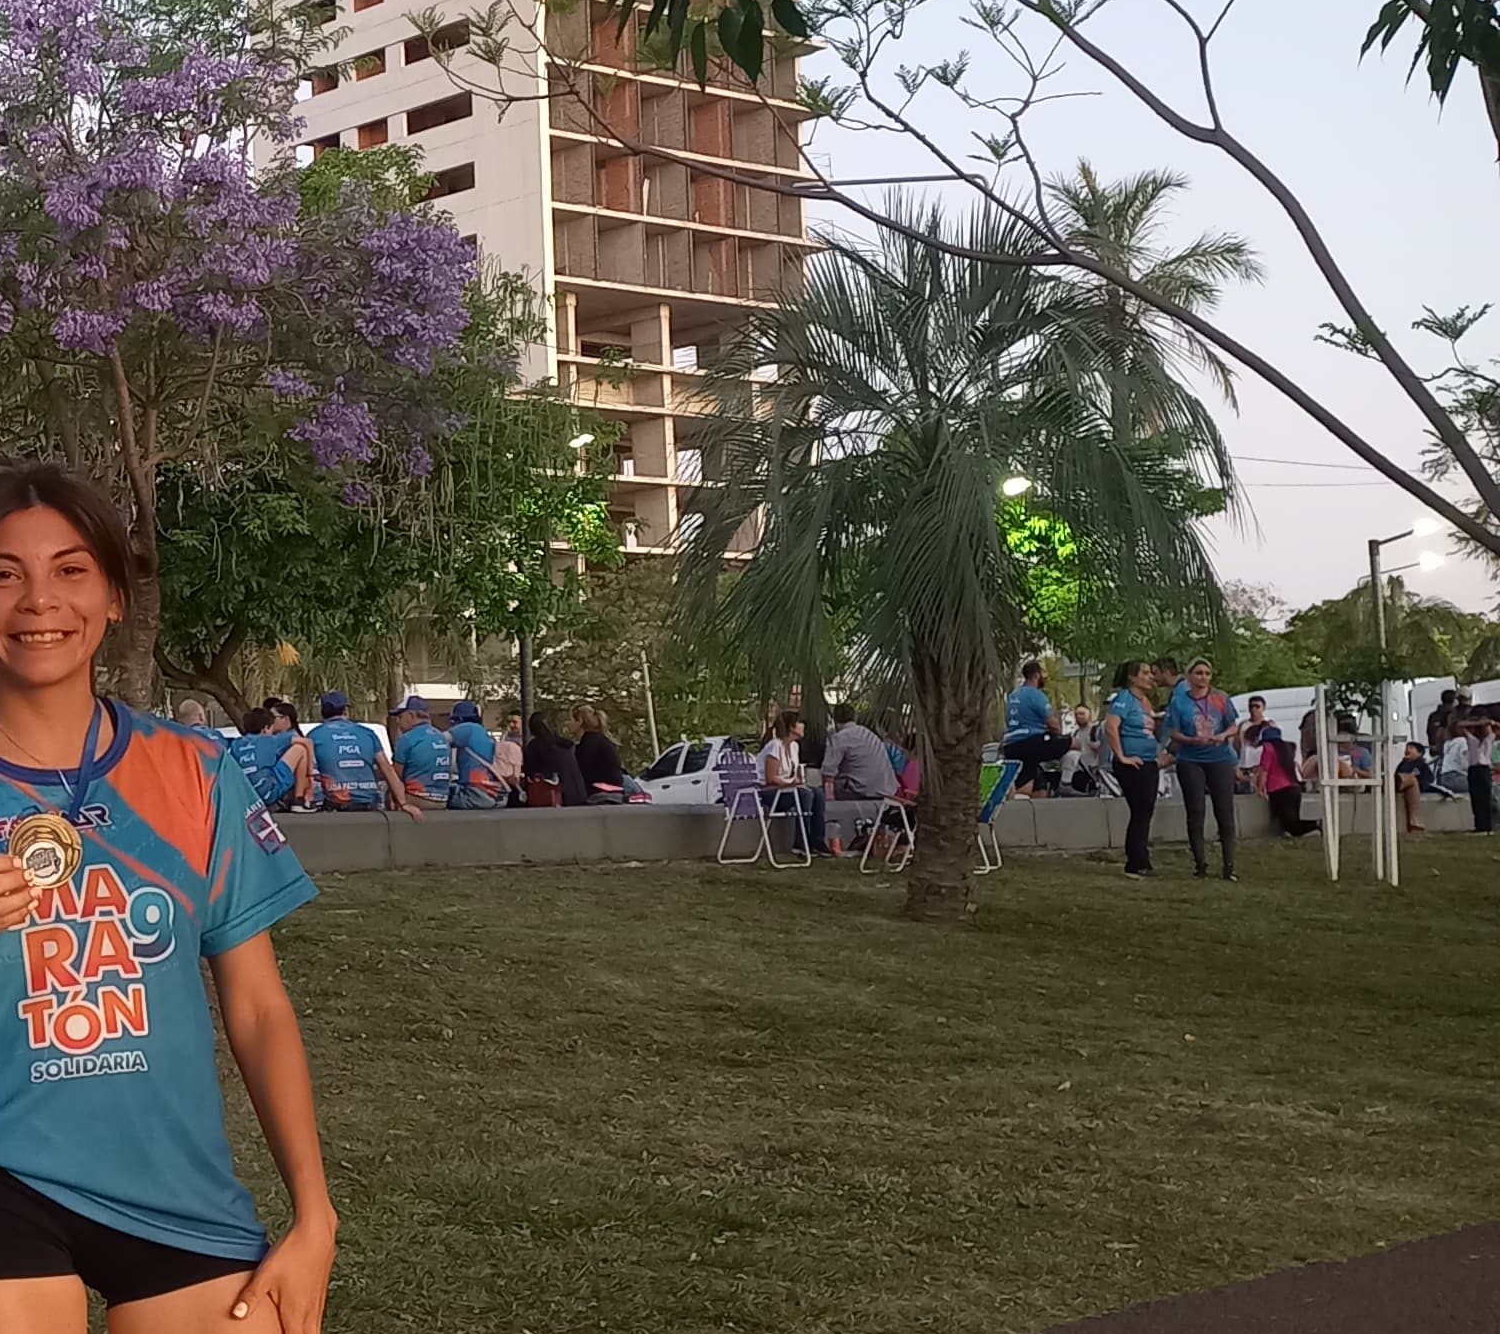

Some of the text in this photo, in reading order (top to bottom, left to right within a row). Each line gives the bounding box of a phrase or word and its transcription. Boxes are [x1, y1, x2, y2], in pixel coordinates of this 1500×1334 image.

[22, 920, 141, 996] RA
[128, 887, 175, 964] 9
[20, 984, 148, 1054] TÓN
[31, 1051, 148, 1083] SOLIDARIA
